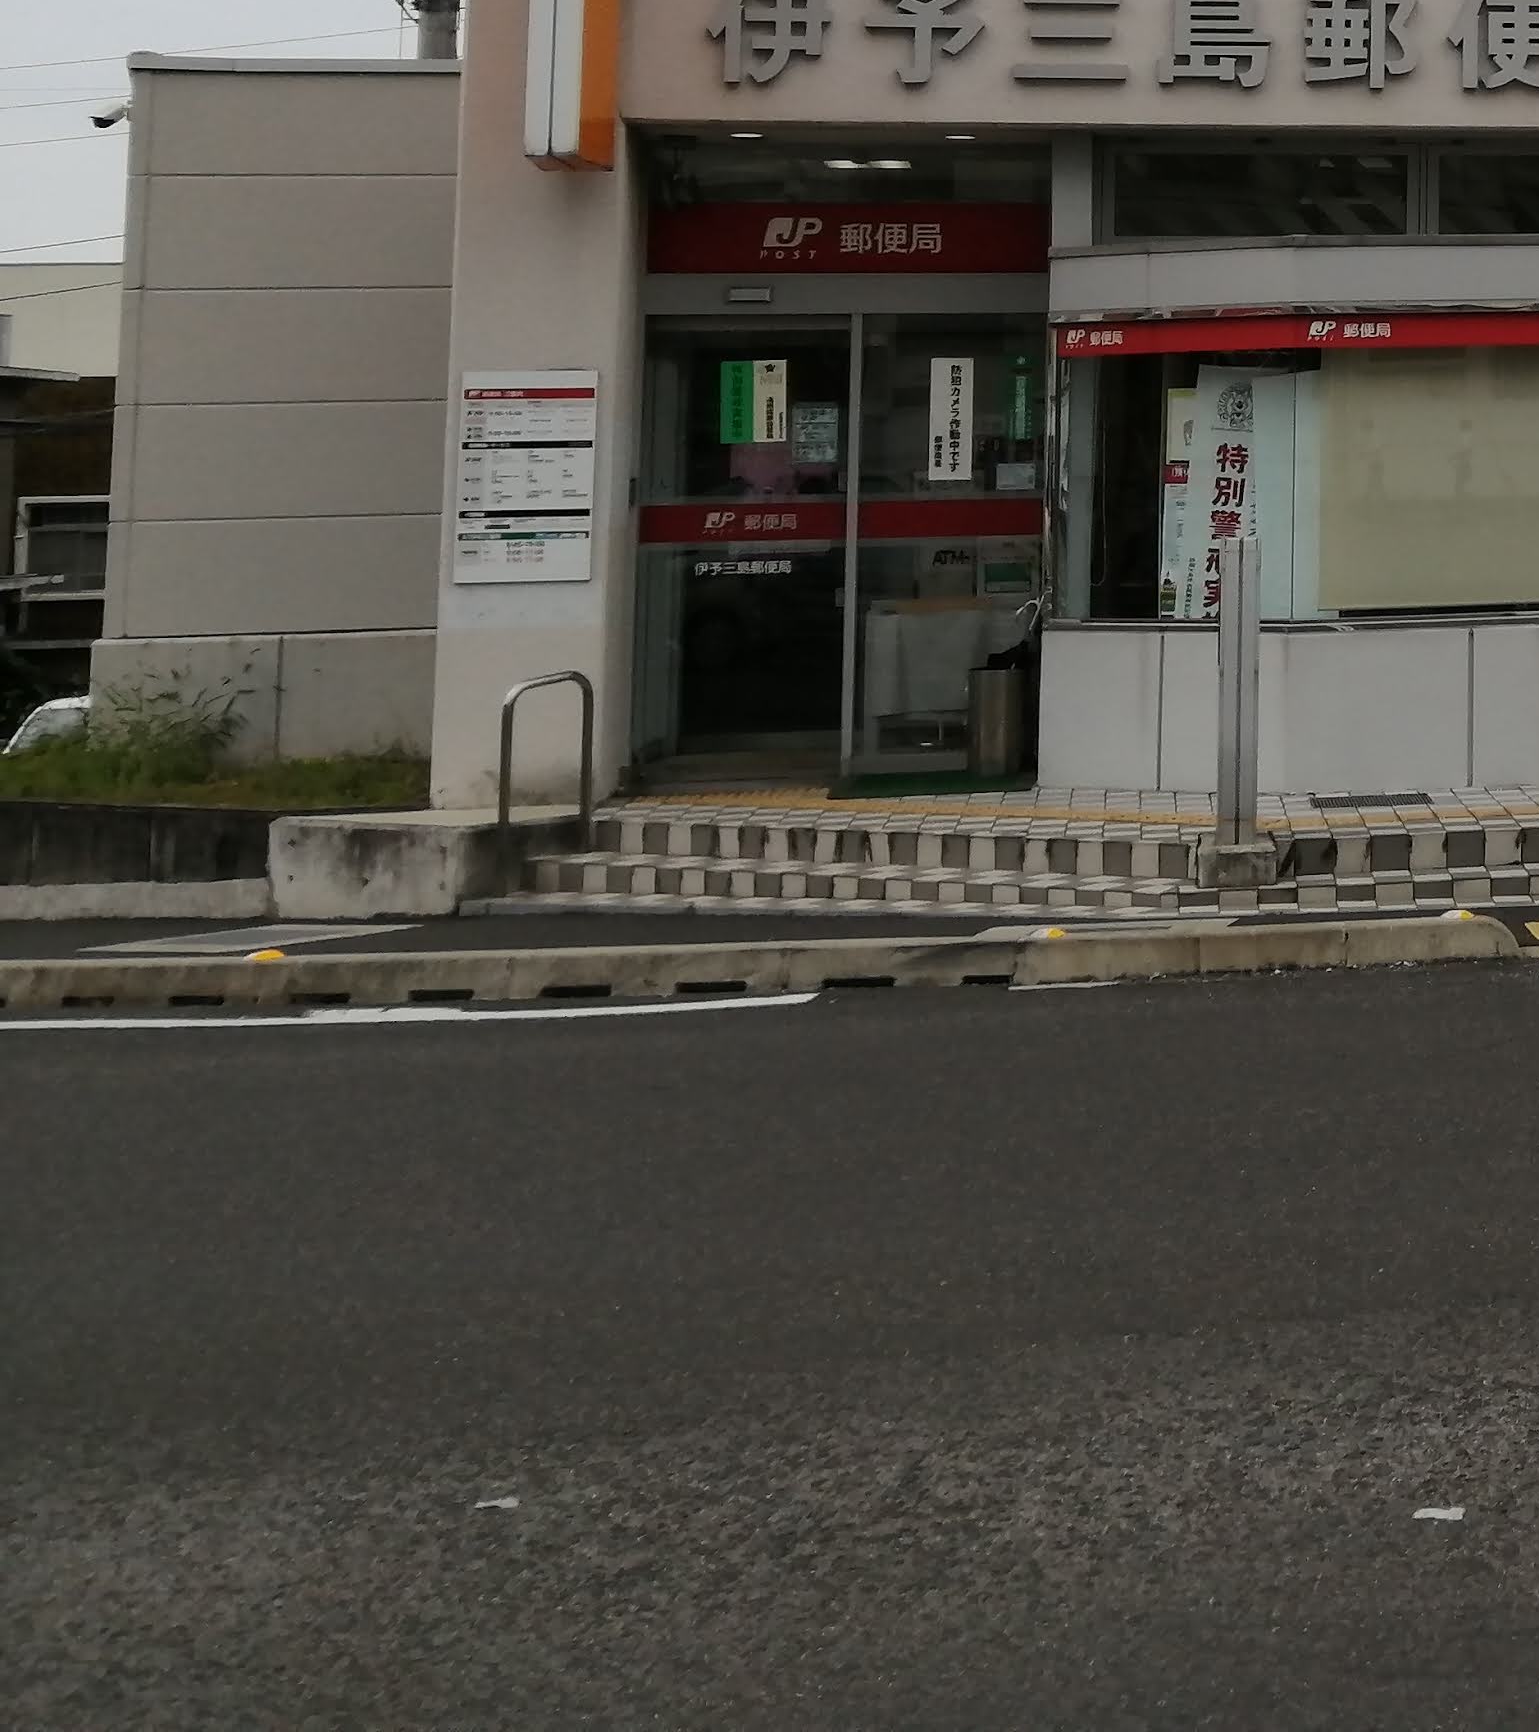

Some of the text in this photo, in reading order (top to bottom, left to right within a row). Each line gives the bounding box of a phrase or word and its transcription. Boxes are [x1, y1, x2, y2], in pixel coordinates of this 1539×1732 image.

[763, 217, 943, 254] JP 郵便局
[1090, 331, 1124, 346] 郵便局
[1343, 323, 1391, 339] 郵便局
[744, 514, 798, 531] 郵便局
[695, 560, 792, 576] 伊予三島郵便局
